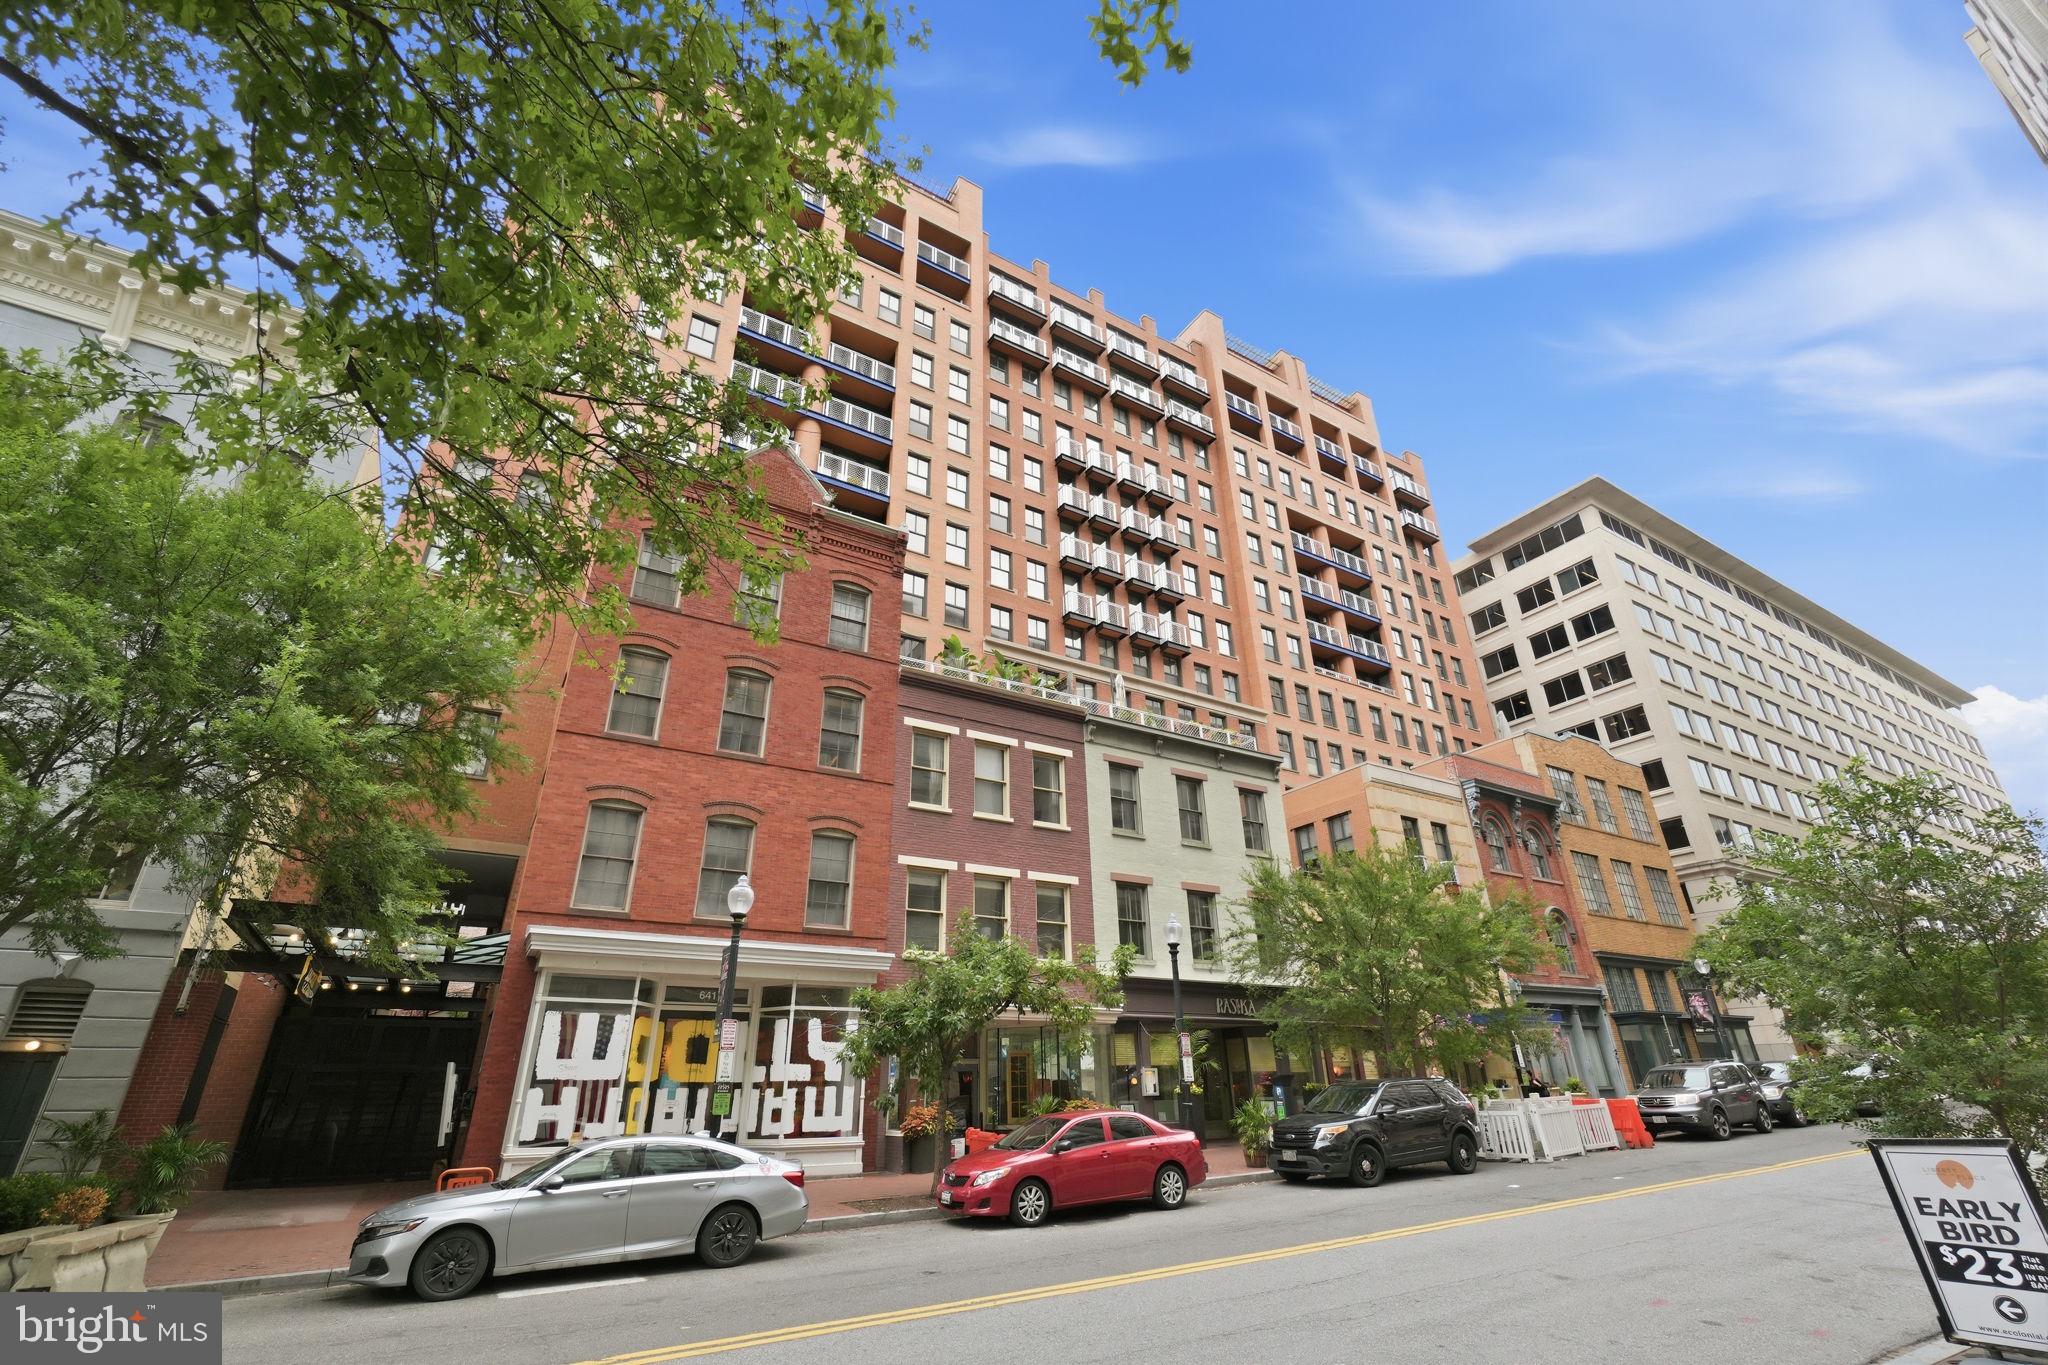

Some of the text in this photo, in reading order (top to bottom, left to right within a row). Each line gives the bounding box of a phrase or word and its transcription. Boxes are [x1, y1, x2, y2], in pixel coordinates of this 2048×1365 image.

[699, 990, 716, 1000] 641
[1913, 1196, 2021, 1223] EARLY
[1937, 1220, 2020, 1246] BIRD
[2021, 1255, 2041, 1264] Flat
[1939, 1244, 2024, 1287] $23
[2022, 1262, 2046, 1271] Rate
[2025, 1273, 2037, 1282] IN
